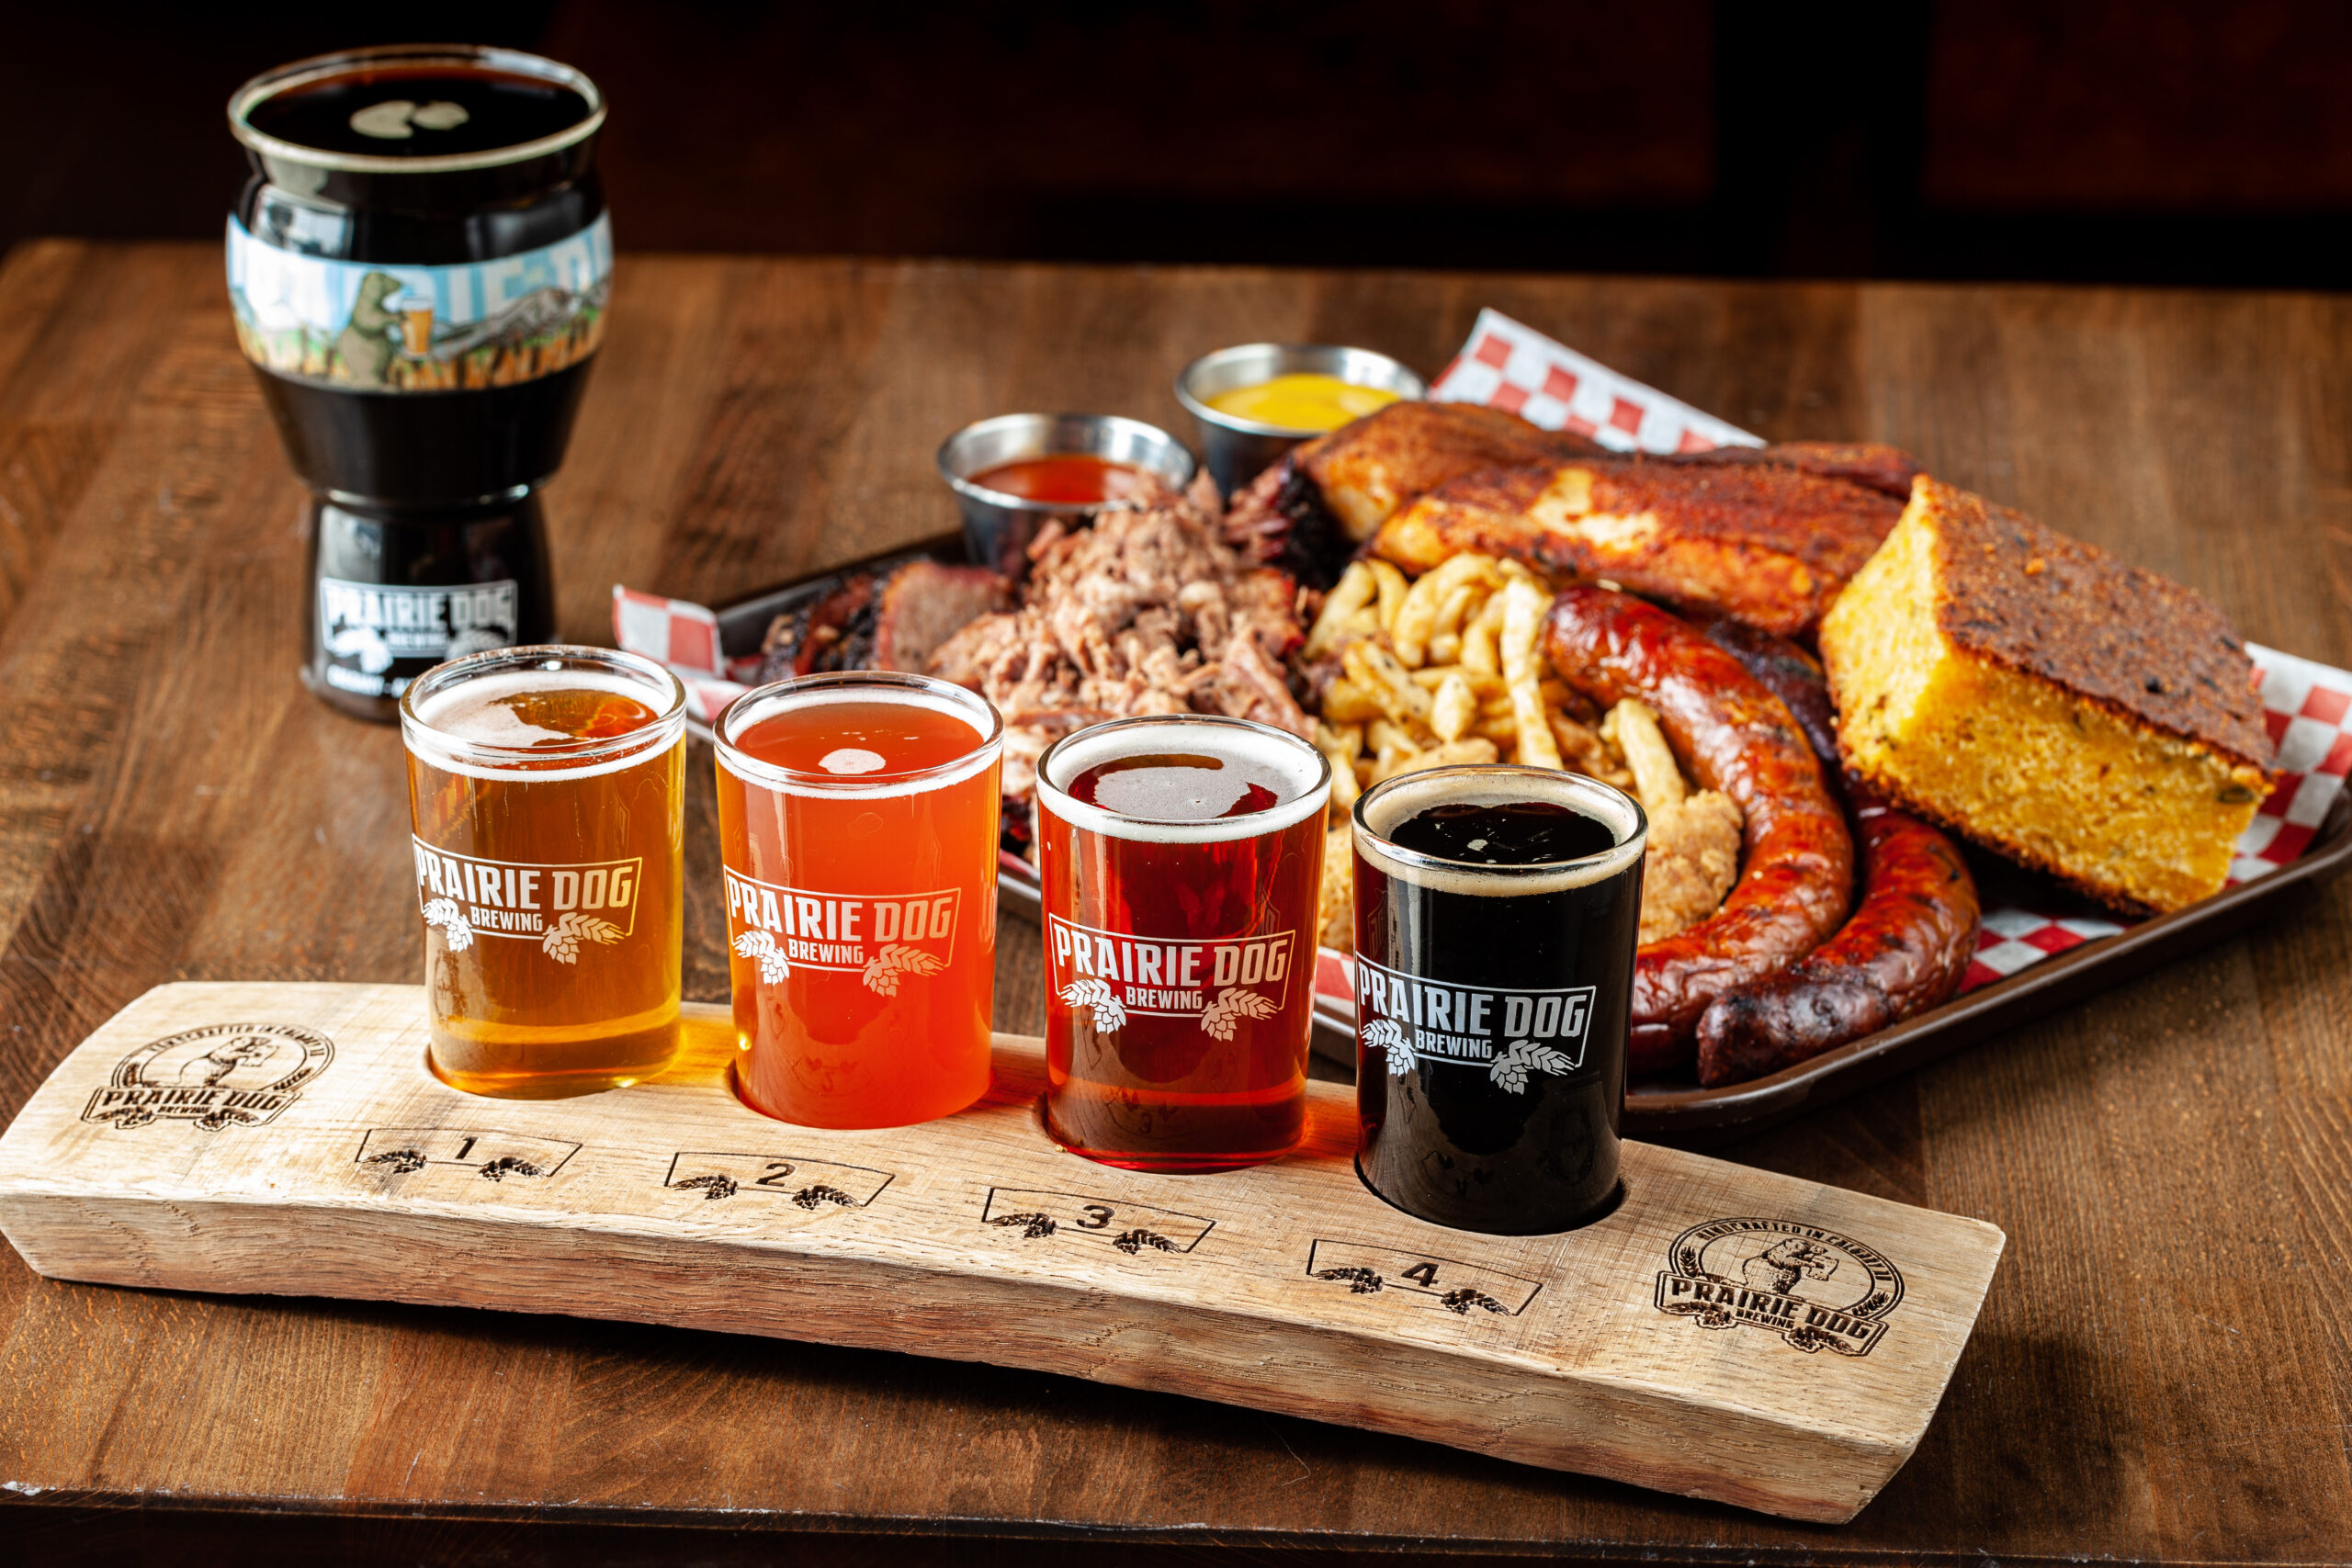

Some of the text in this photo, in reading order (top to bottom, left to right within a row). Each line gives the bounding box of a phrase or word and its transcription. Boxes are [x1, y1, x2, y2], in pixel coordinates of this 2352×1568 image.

[413, 843, 633, 910] PRAIRIE DOG
[470, 906, 543, 931] BREWING
[727, 874, 953, 942] PRAIRIE DOG
[788, 938, 864, 964] BREWING
[1054, 923, 1288, 987] PRAIRIE DOG
[1125, 986, 1203, 1010] BREWING
[1358, 961, 1588, 1038] PRAIRIE DOG
[1415, 1029, 1493, 1059] BREWING
[102, 1089, 289, 1110] PRAIRIE DOG
[456, 1136, 479, 1159] 1
[755, 1162, 797, 1187] 2
[1076, 1204, 1115, 1229] 3
[1696, 1220, 1801, 1241] HANDCRAFTED
[1805, 1228, 1825, 1240] IN
[1402, 1261, 1441, 1287] 4
[1670, 1278, 1874, 1339] PRAIRIE DOG
[1736, 1308, 1796, 1329] BREWING
